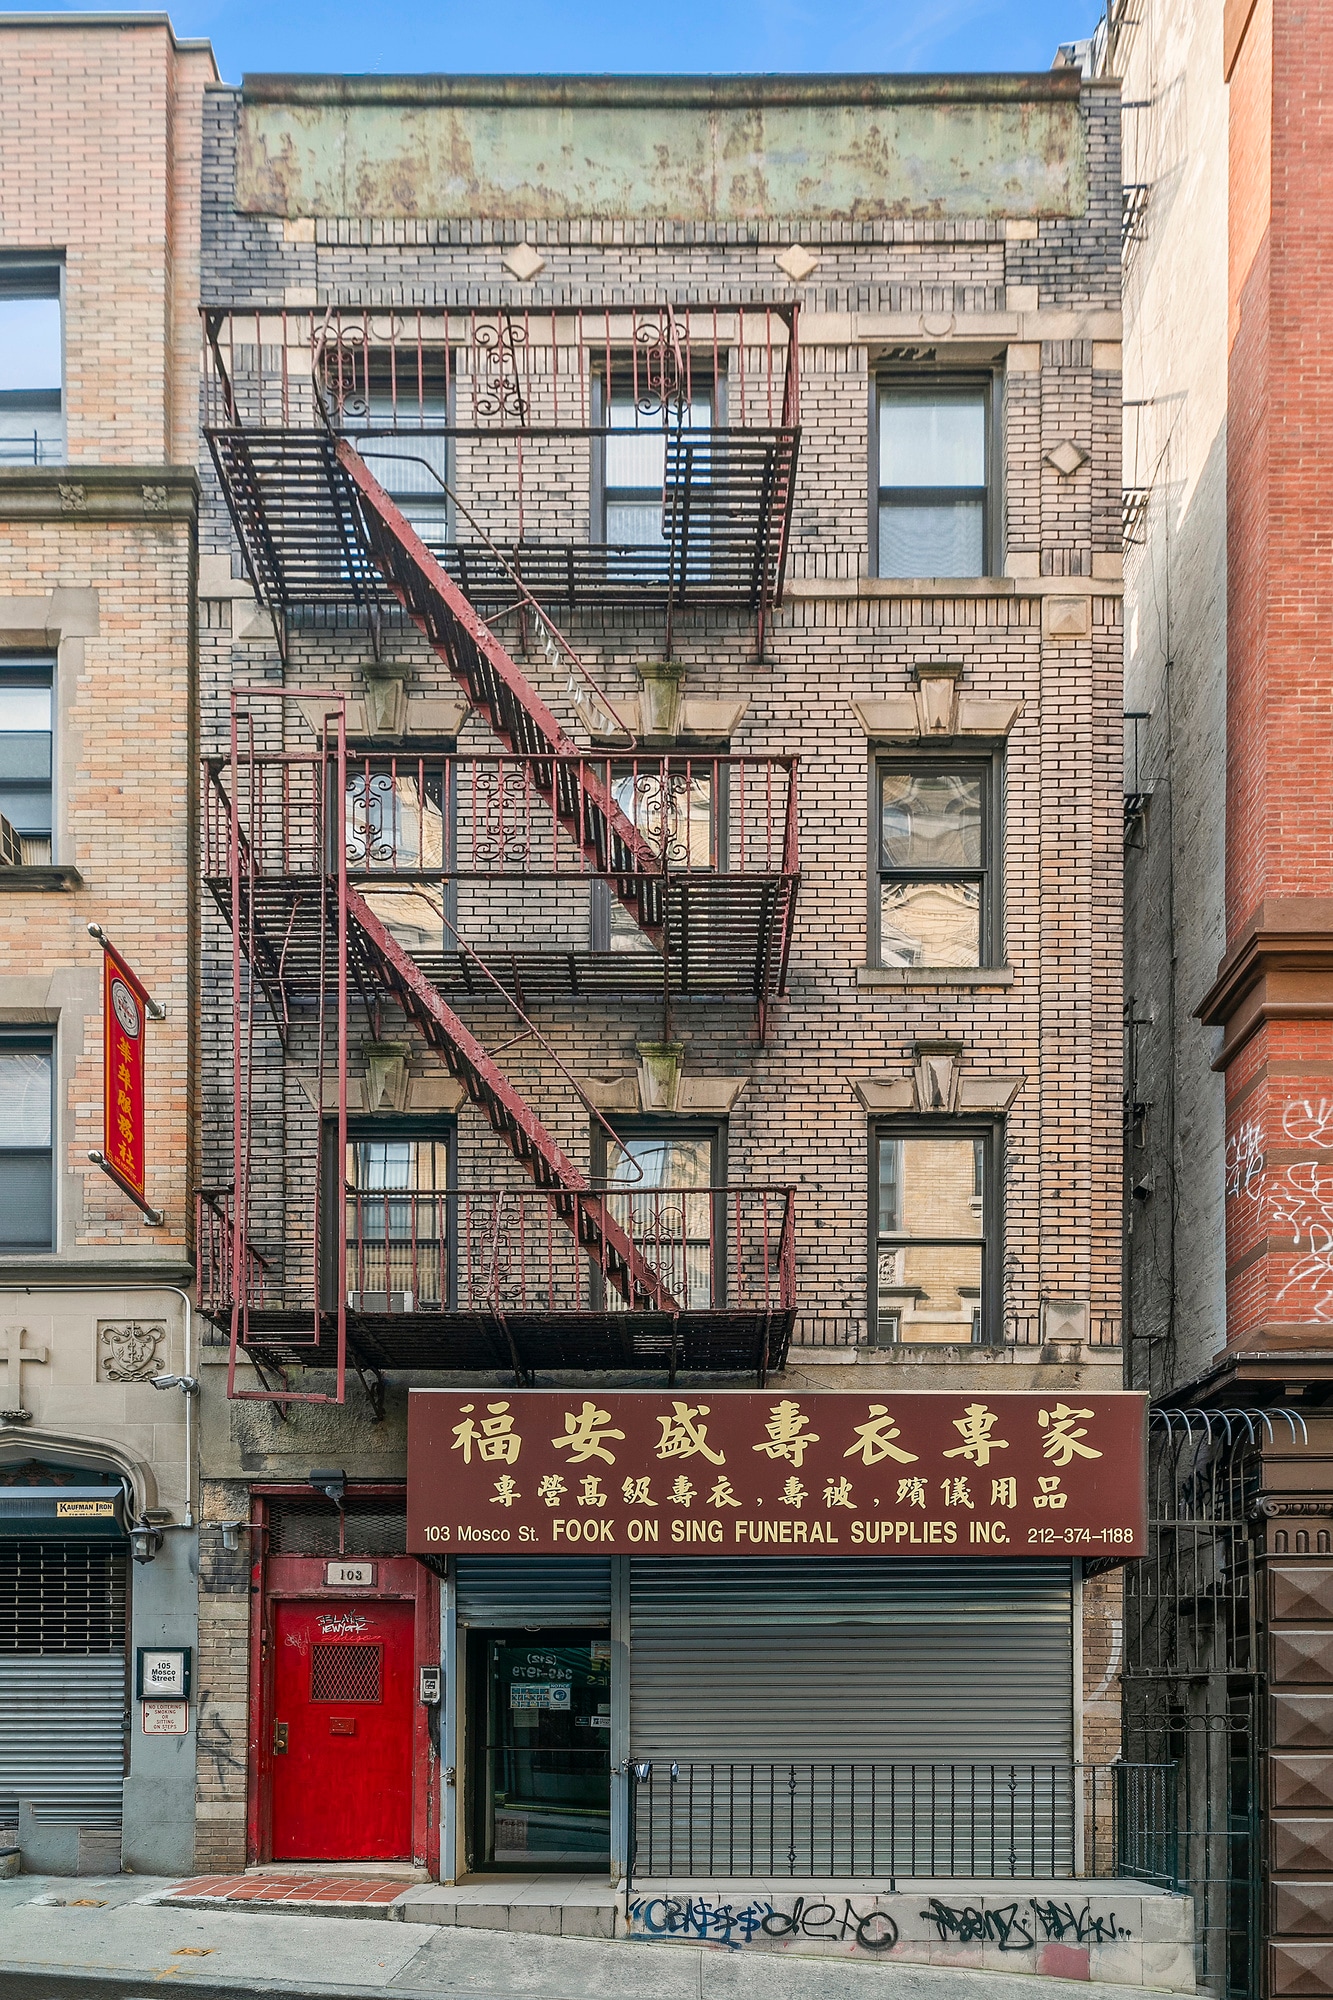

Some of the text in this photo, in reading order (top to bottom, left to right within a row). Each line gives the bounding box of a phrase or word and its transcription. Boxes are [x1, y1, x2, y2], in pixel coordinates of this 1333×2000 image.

[60, 1503, 112, 1512] KAUFMAN IRON
[424, 1519, 1133, 1543] 103 Mosco St. FOOK ON SING FUNERAL SUPPLIES INC. 212-374-1188
[340, 1569, 362, 1580] 103
